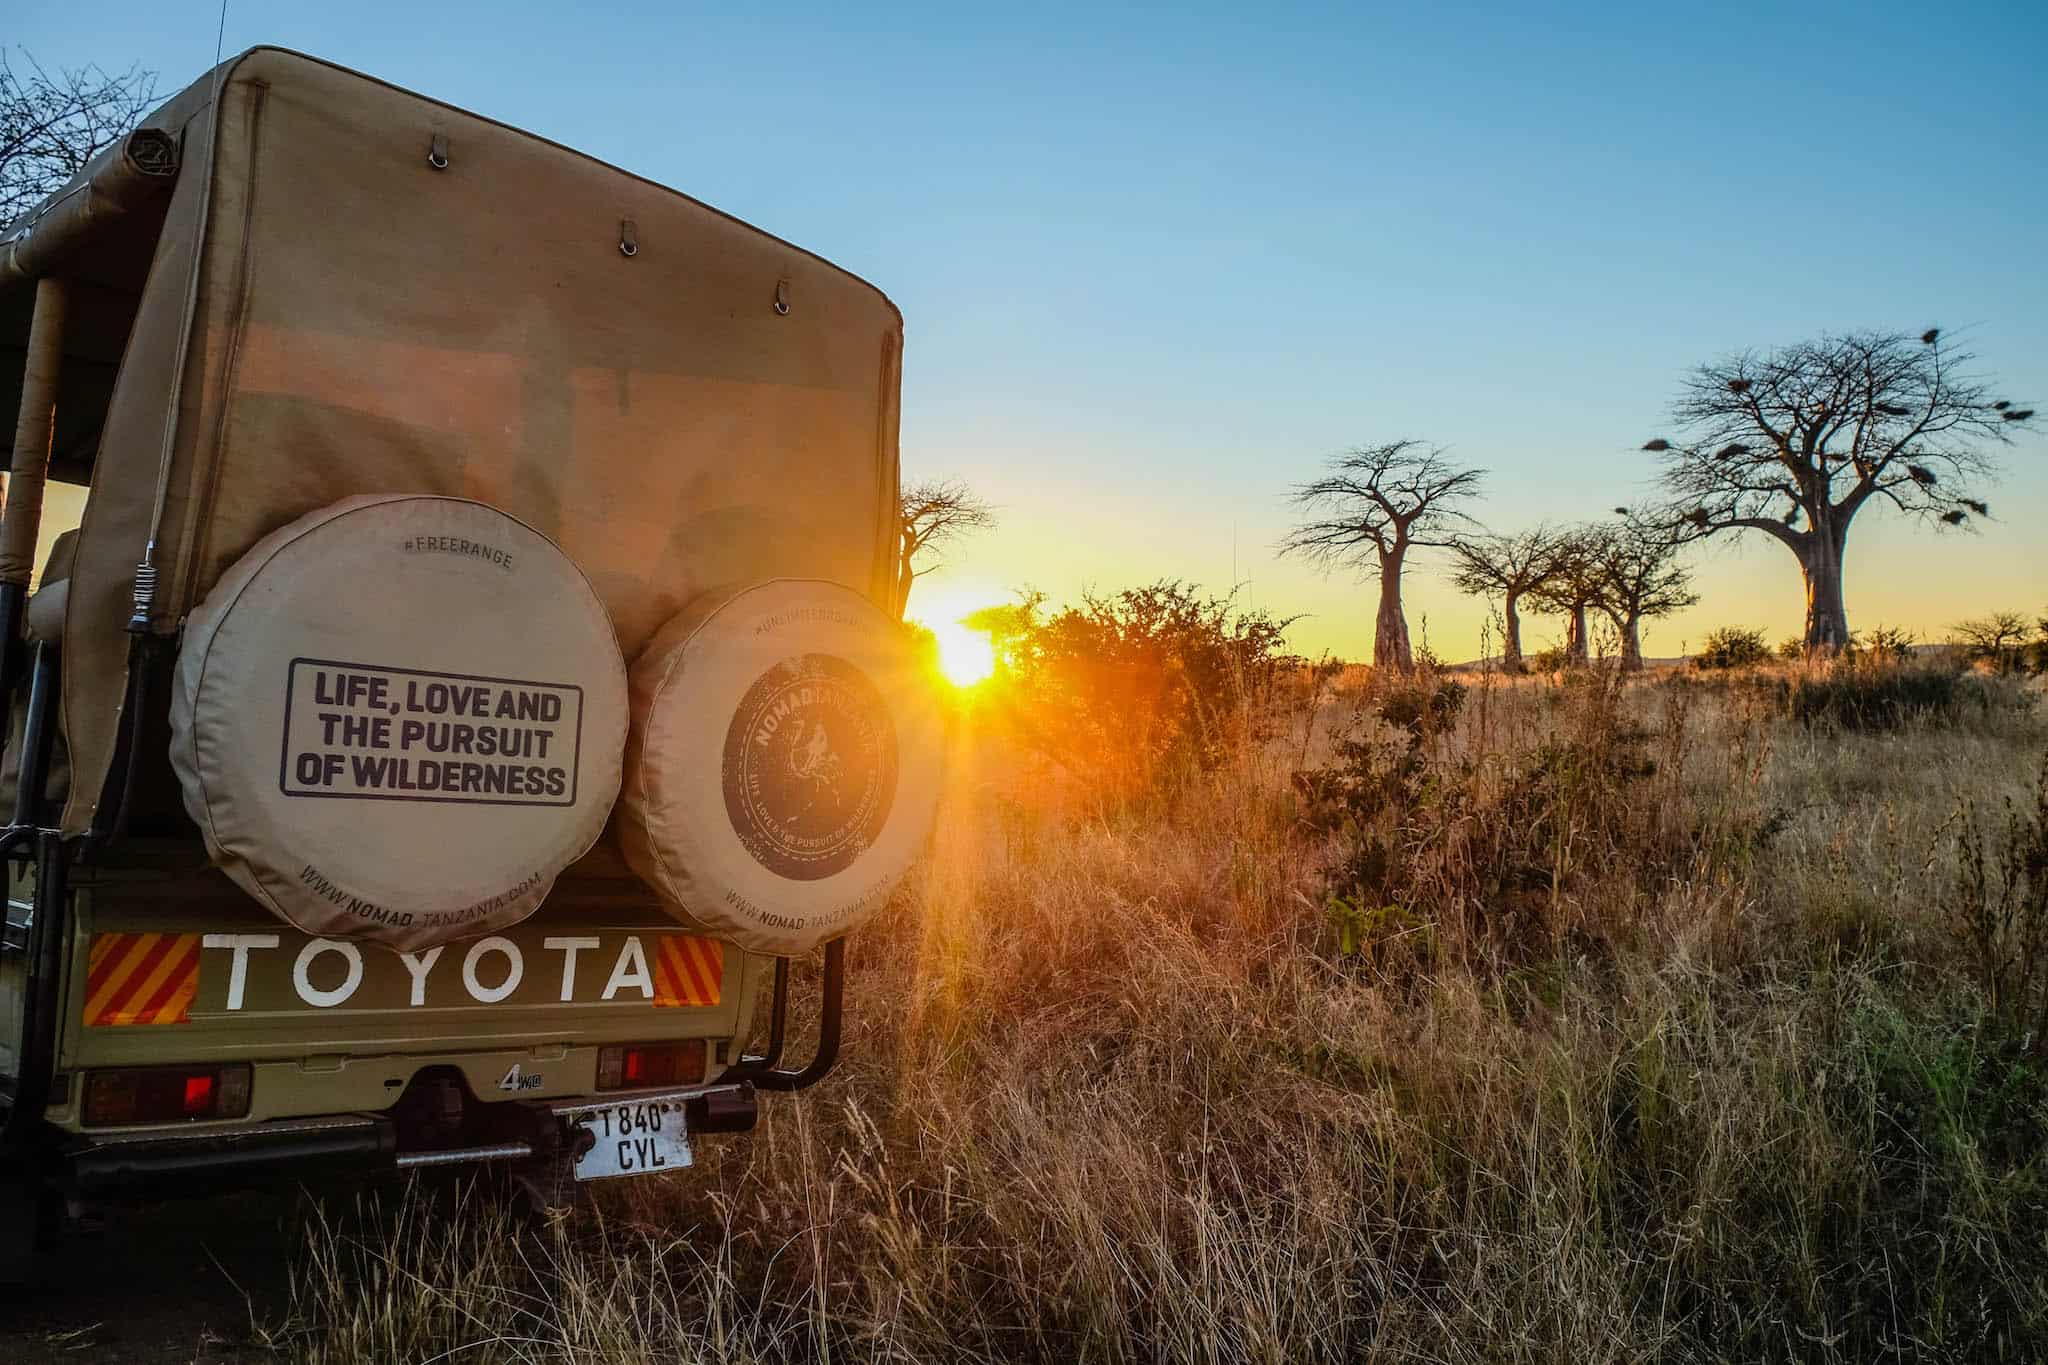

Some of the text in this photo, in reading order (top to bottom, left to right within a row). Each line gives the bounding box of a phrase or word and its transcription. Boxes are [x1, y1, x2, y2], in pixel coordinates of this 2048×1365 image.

[405, 536, 513, 569] #FREERANGE
[315, 671, 562, 722] LIFE, LOVE AND
[318, 712, 554, 758] THE PURSUIT
[296, 751, 566, 796] OF WILDERNESS
[202, 934, 656, 1010] TOYOTA
[598, 1102, 662, 1137] T 840
[617, 1138, 665, 1170] CYL
